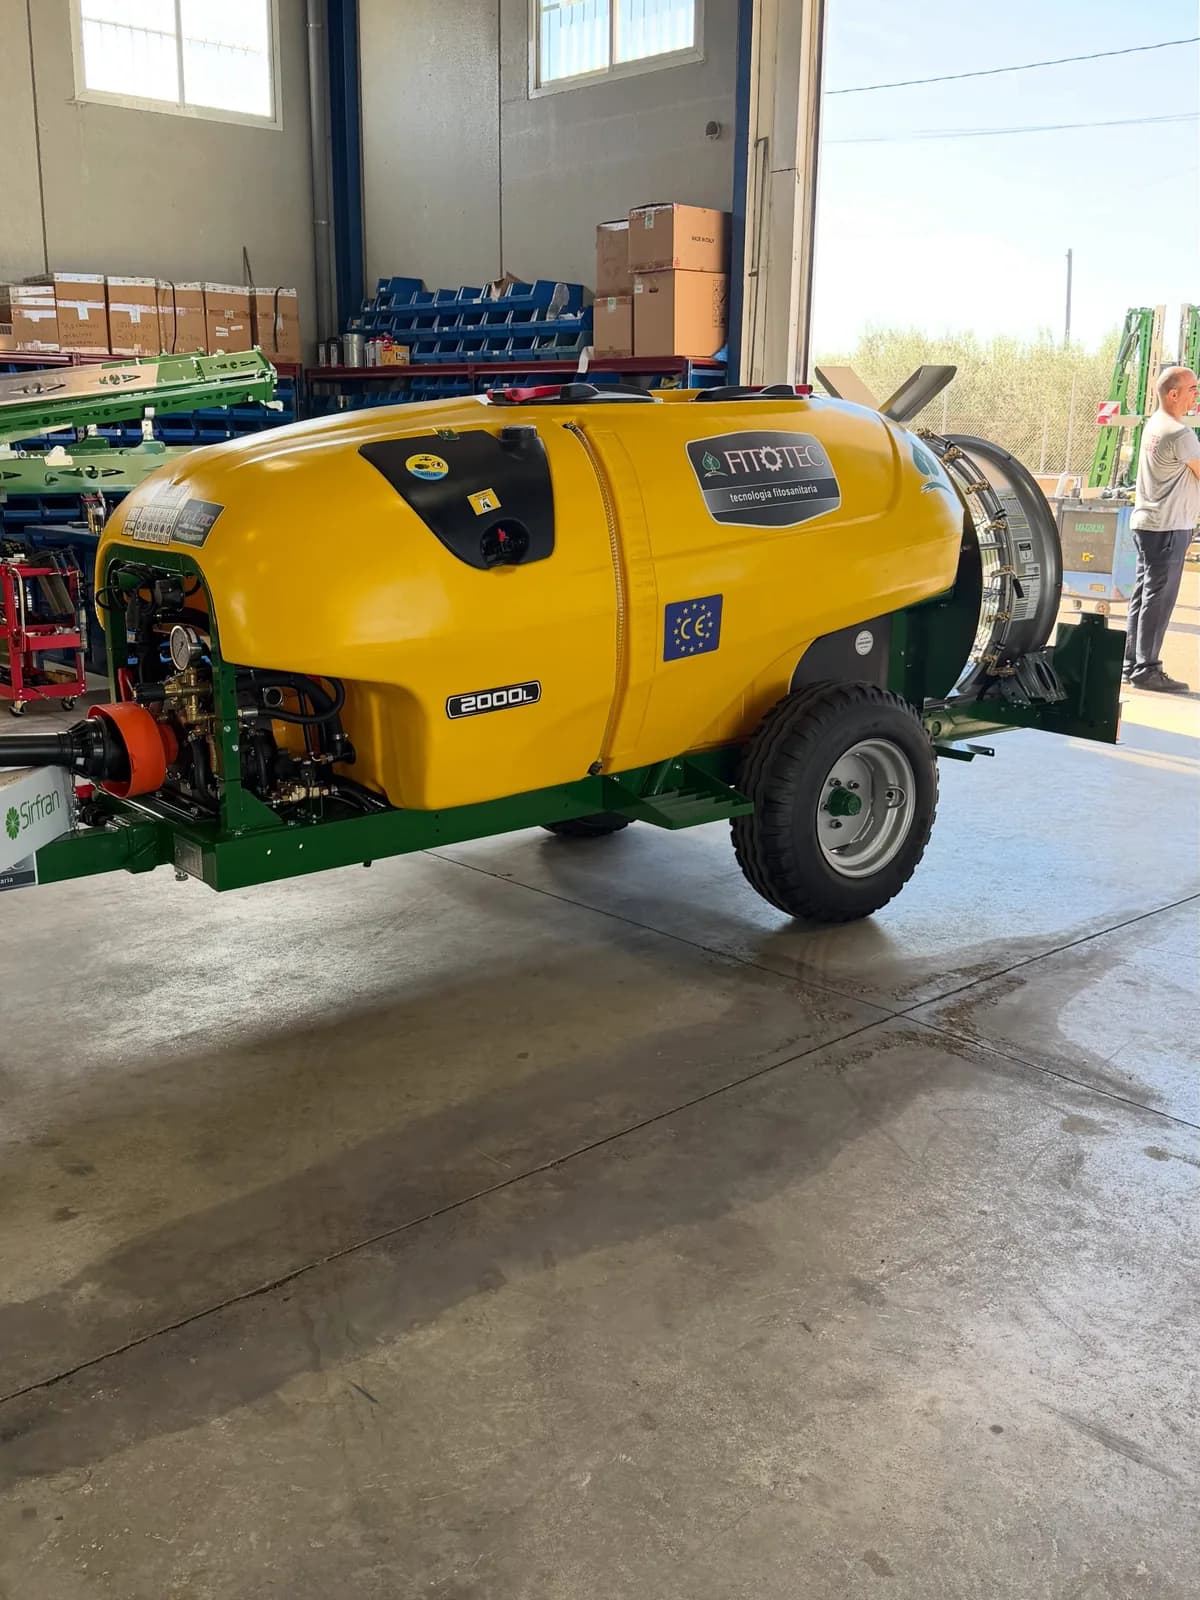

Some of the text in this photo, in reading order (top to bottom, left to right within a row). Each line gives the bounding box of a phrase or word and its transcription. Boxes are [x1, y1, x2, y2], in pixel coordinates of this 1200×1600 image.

[723, 445, 824, 474] FITOTEC
[729, 484, 818, 503] tecnologia fitosanitaria
[680, 615, 706, 640] CE
[20, 790, 61, 830] Sirfran
